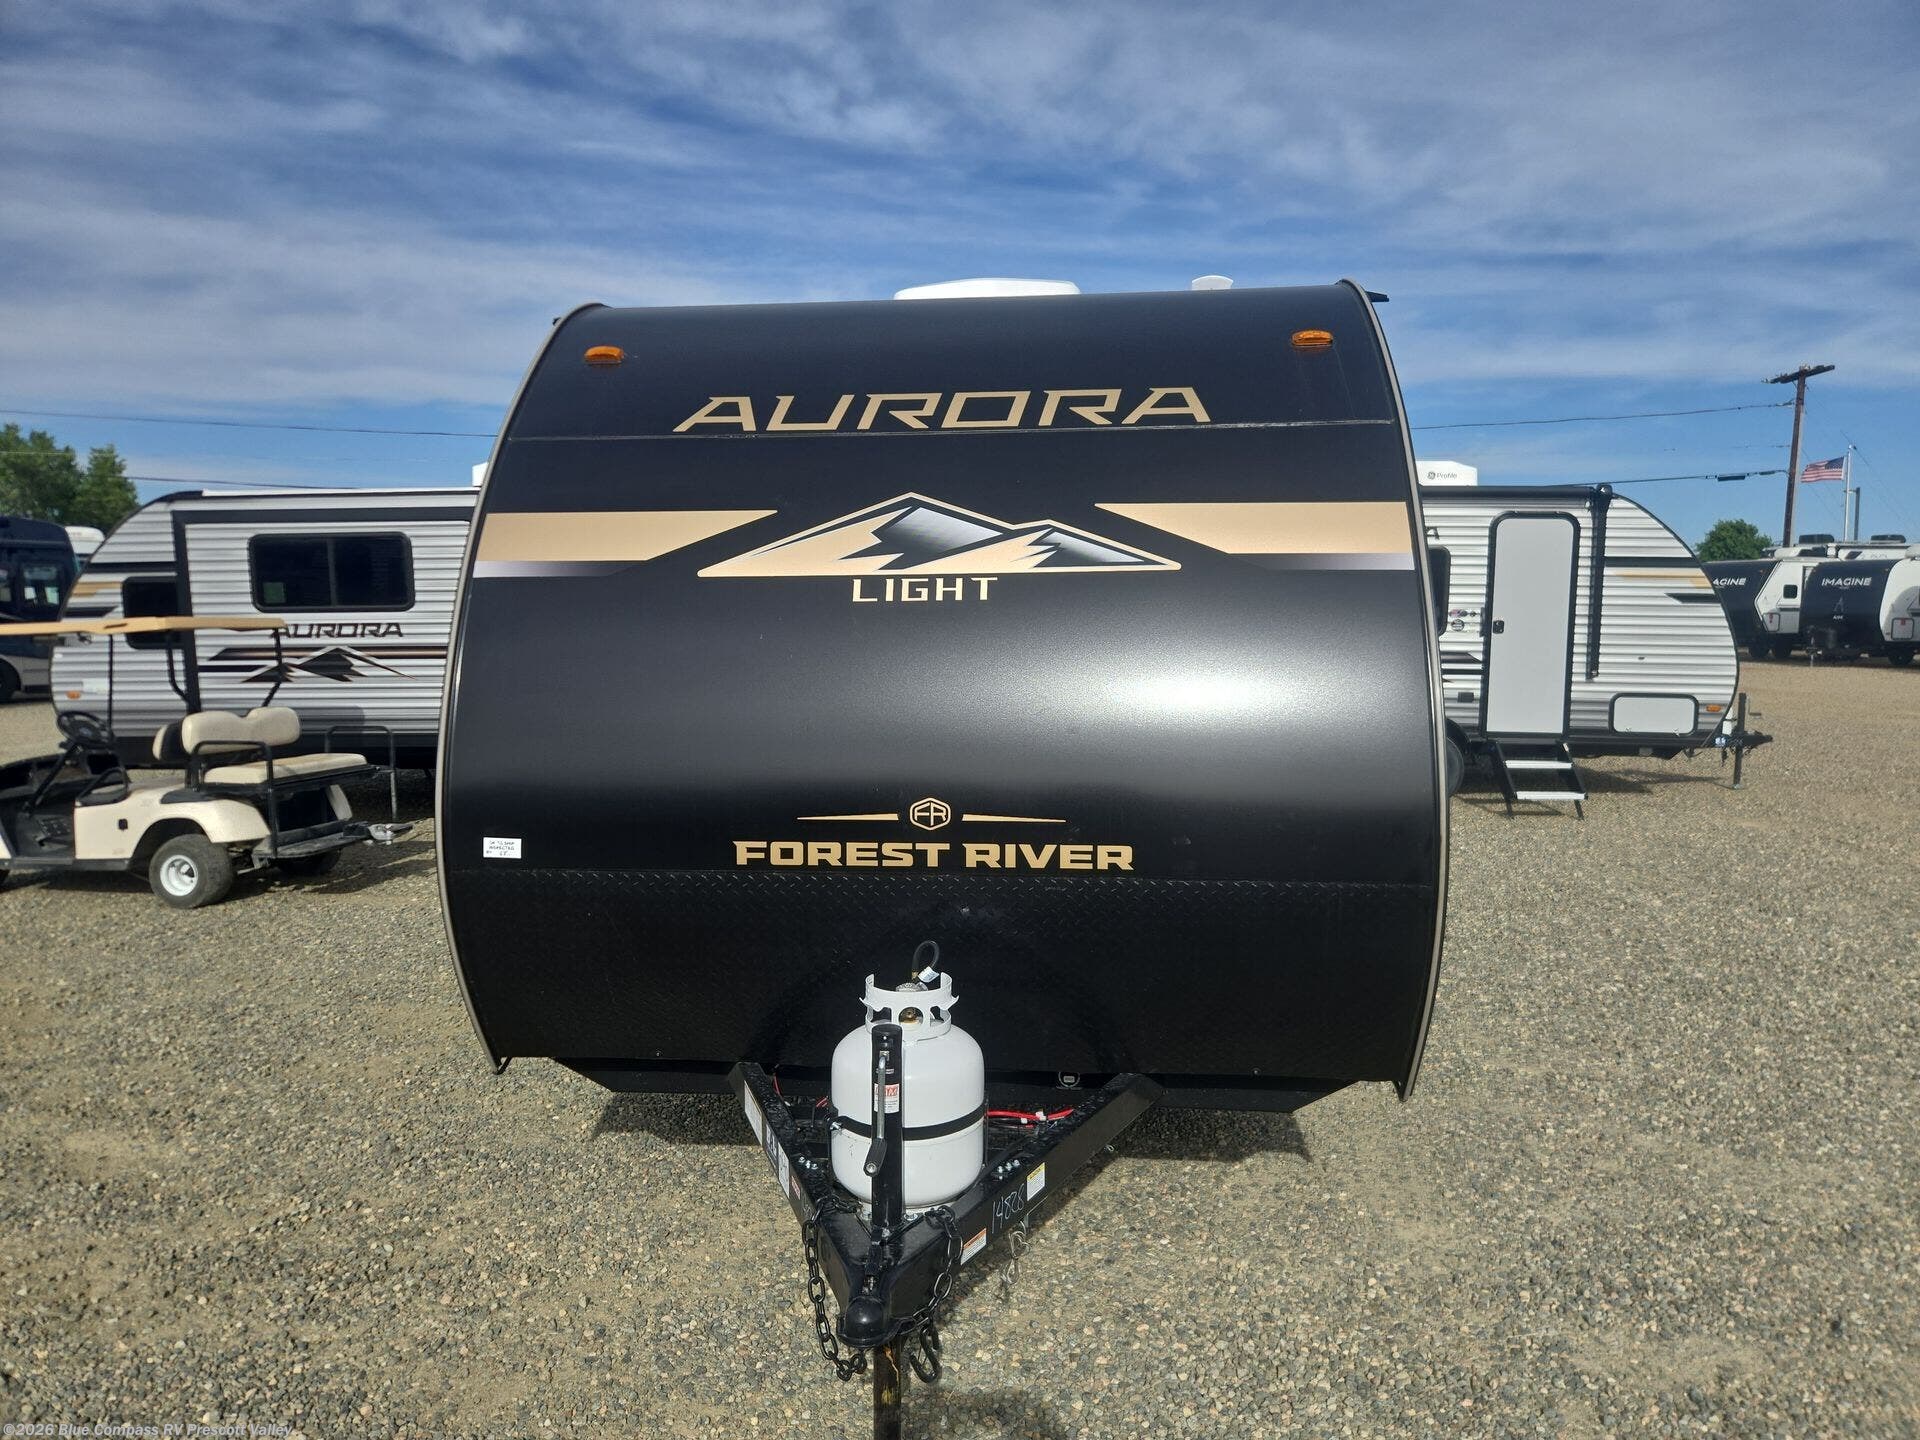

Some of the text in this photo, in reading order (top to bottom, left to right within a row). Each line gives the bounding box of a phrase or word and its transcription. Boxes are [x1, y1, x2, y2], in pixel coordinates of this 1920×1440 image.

[673, 387, 1211, 432] AURORA
[852, 576, 999, 602] LIGHT
[1712, 577, 1747, 586] AGINE
[1821, 577, 1872, 586] IMAGINE
[732, 841, 1135, 871] FOREST RIVER
